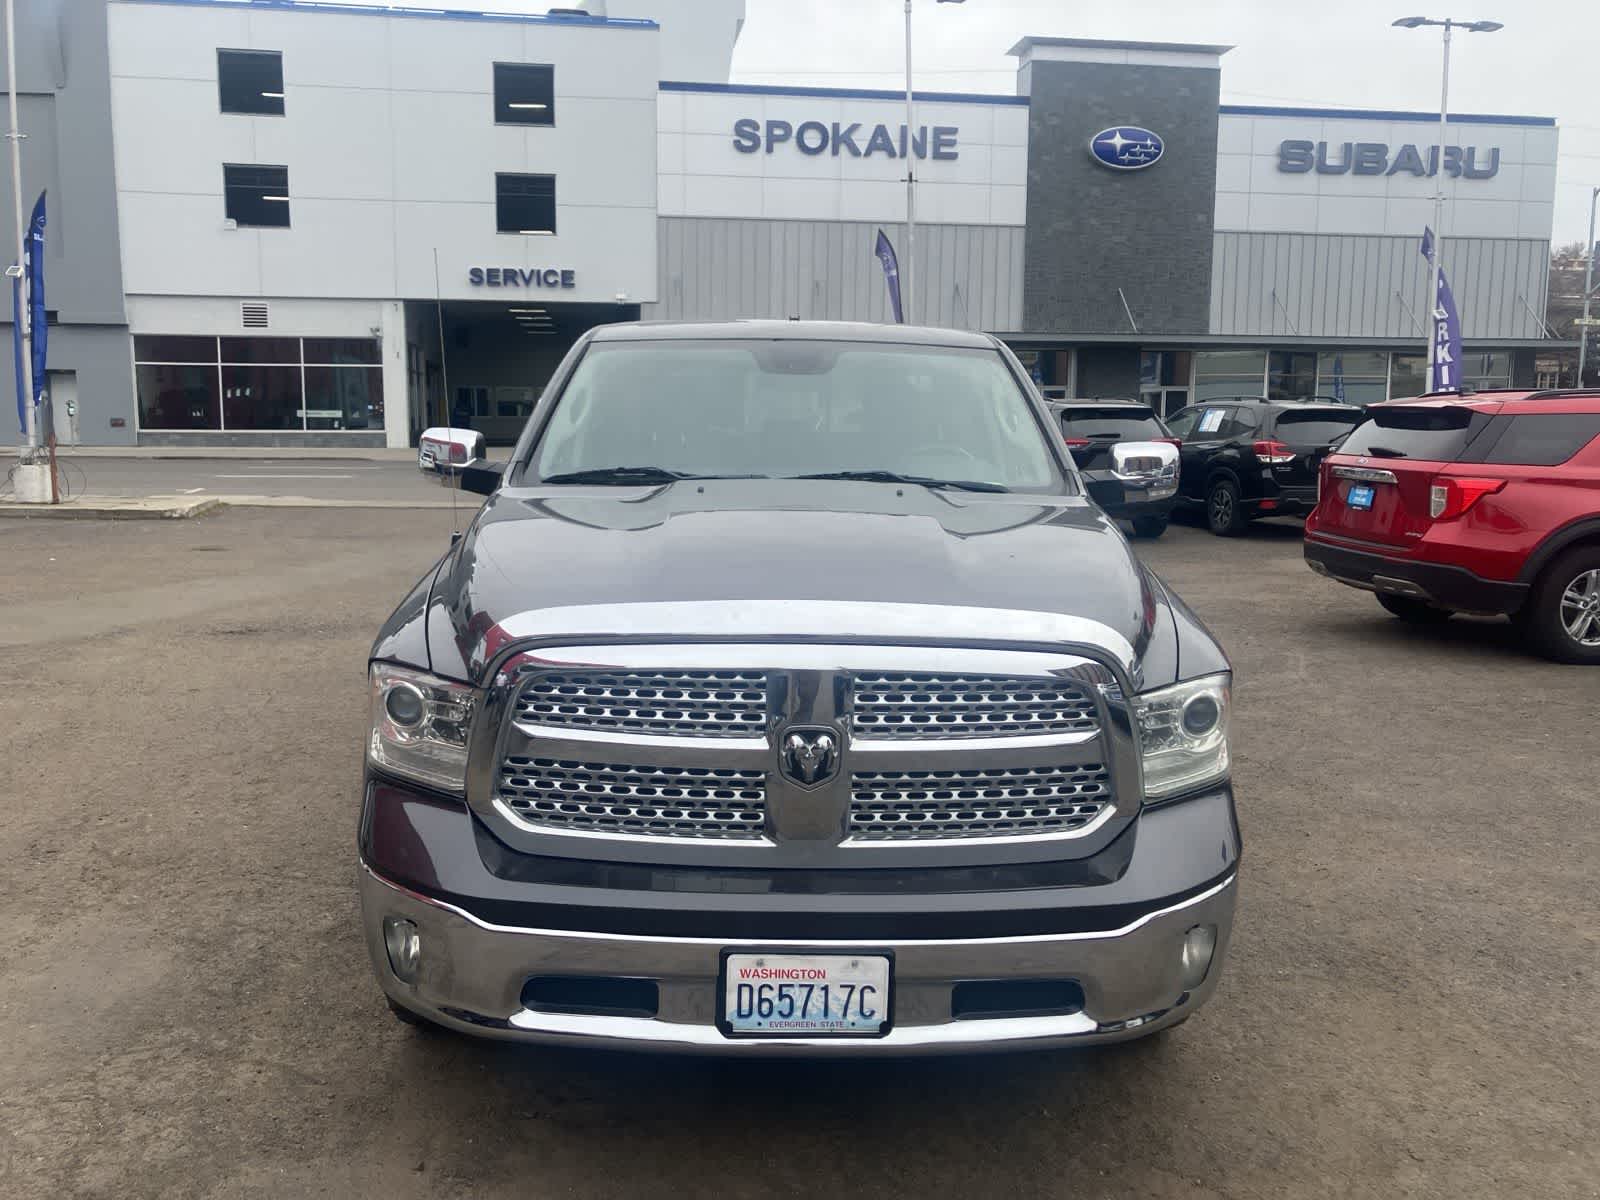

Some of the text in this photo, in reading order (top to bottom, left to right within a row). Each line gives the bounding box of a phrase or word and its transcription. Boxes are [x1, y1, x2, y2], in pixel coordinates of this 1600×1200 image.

[733, 118, 959, 161] SPOKANE
[1278, 139, 1500, 180] SUBARU
[469, 267, 576, 288] SERVICE
[739, 968, 827, 980] WASHINGTON
[736, 983, 877, 1020] D65717C
[769, 1021, 845, 1029] EVERGREEN STATE
